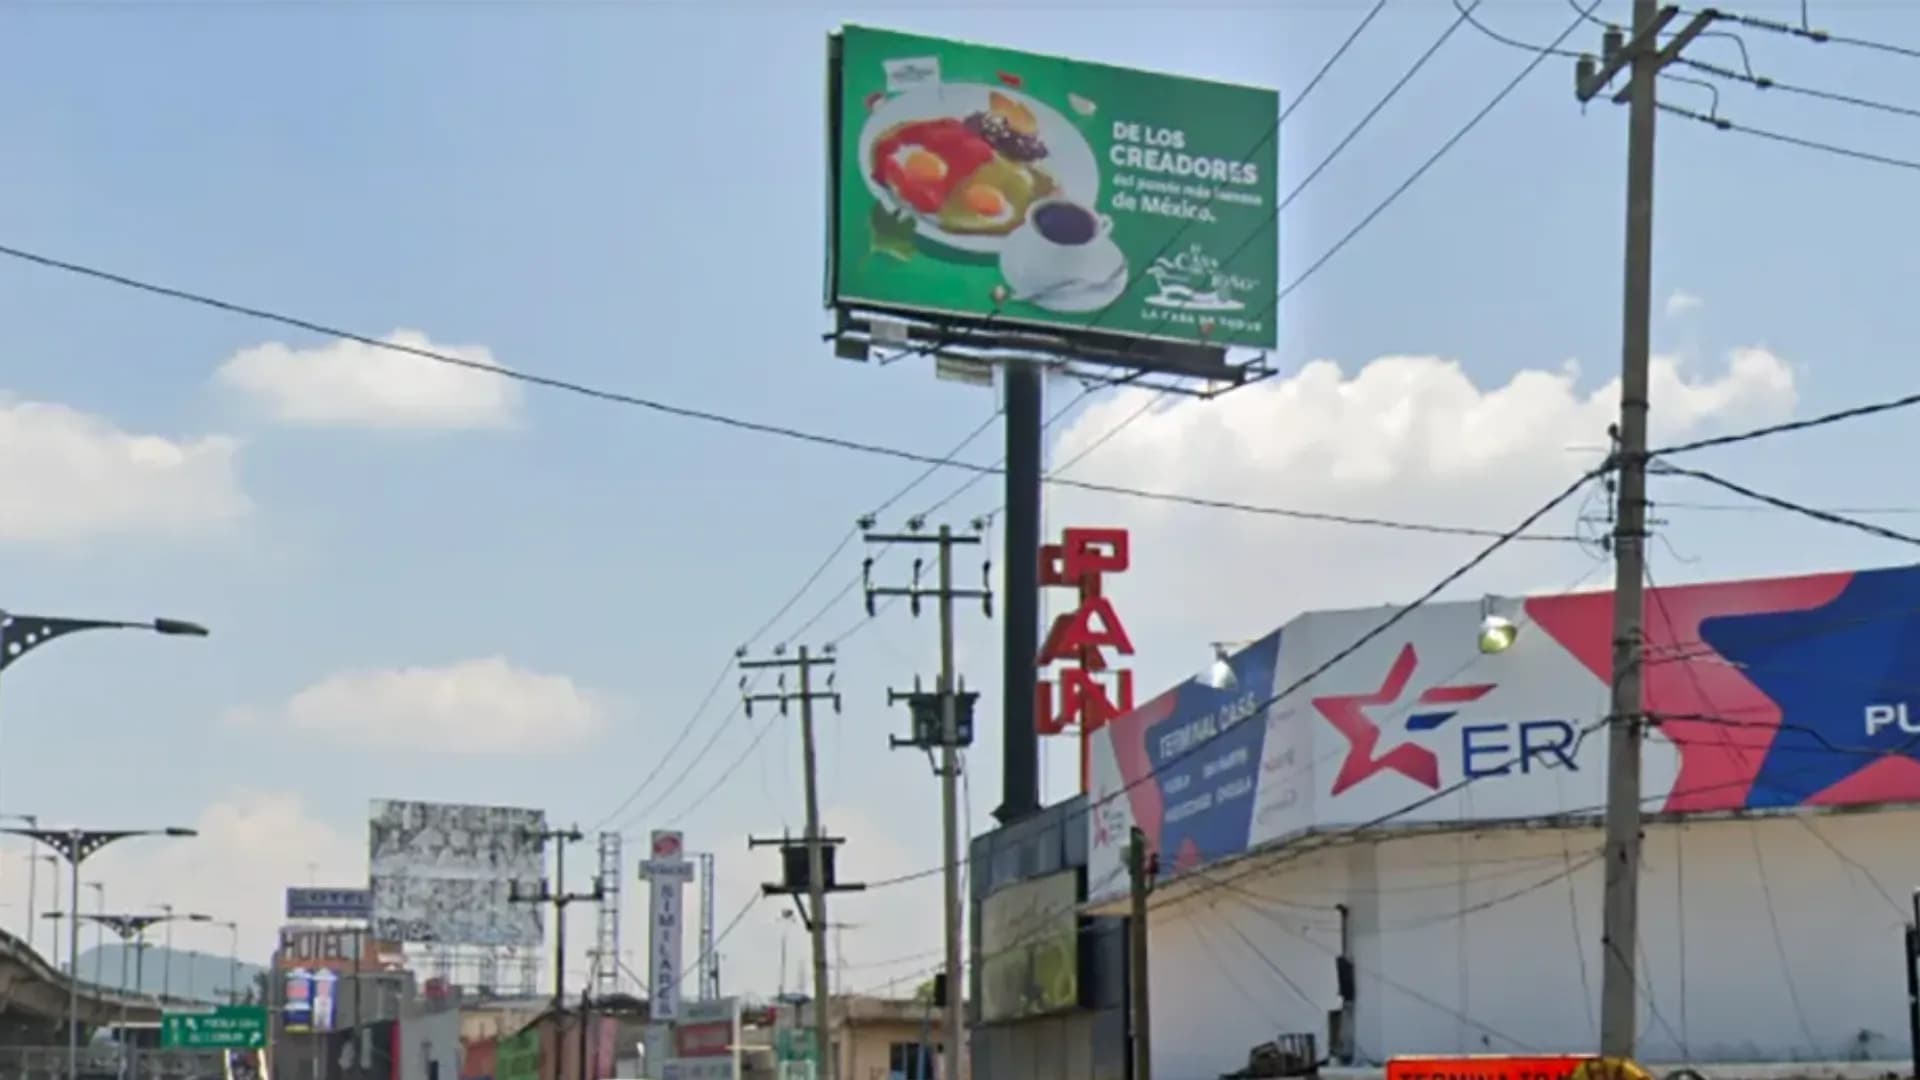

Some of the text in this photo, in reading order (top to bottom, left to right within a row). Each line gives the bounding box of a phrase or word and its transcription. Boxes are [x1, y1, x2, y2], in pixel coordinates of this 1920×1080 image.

[1112, 121, 1186, 149] DE LOS
[1109, 146, 1259, 184] CREADORES
[1112, 190, 1137, 211] de
[1865, 702, 1920, 736] PU
[1462, 720, 1578, 778] ER
